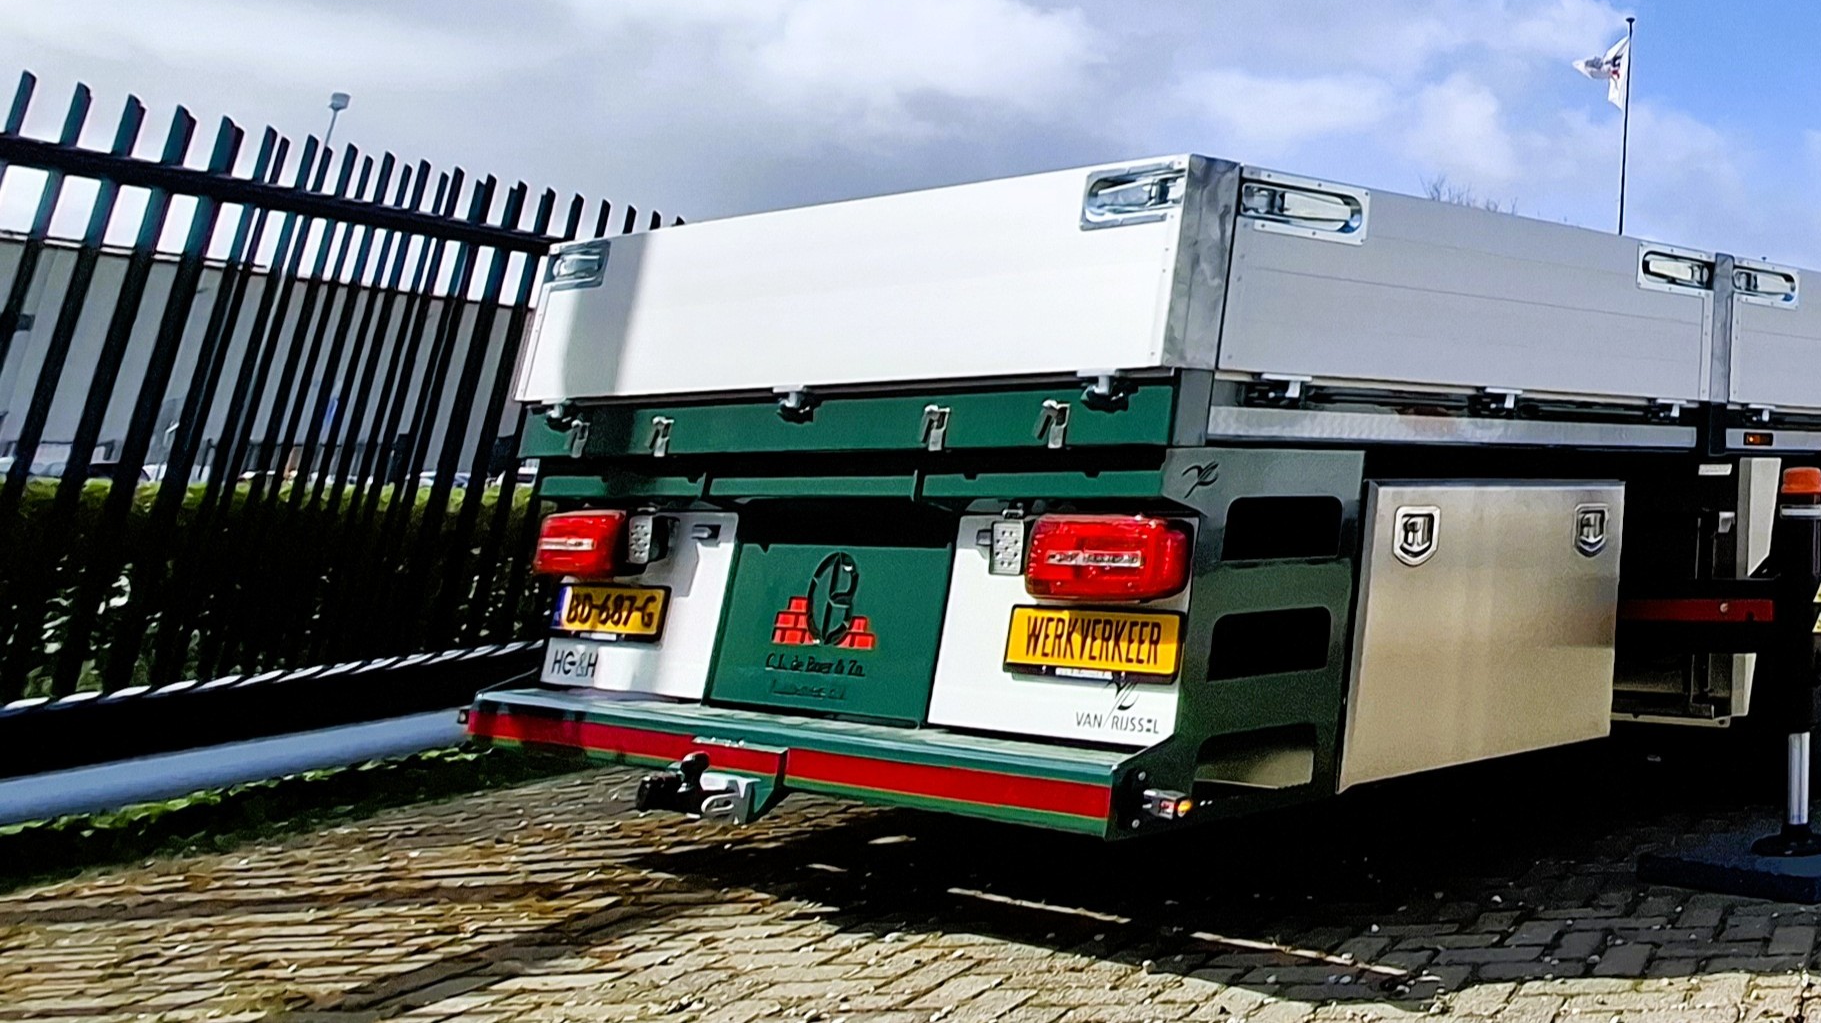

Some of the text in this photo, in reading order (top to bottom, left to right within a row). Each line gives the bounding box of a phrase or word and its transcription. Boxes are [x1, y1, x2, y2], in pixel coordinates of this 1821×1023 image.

[566, 592, 657, 628] BD-687-G
[1025, 615, 1163, 666] WERKVERKEER
[1075, 711, 1103, 729] VAN
